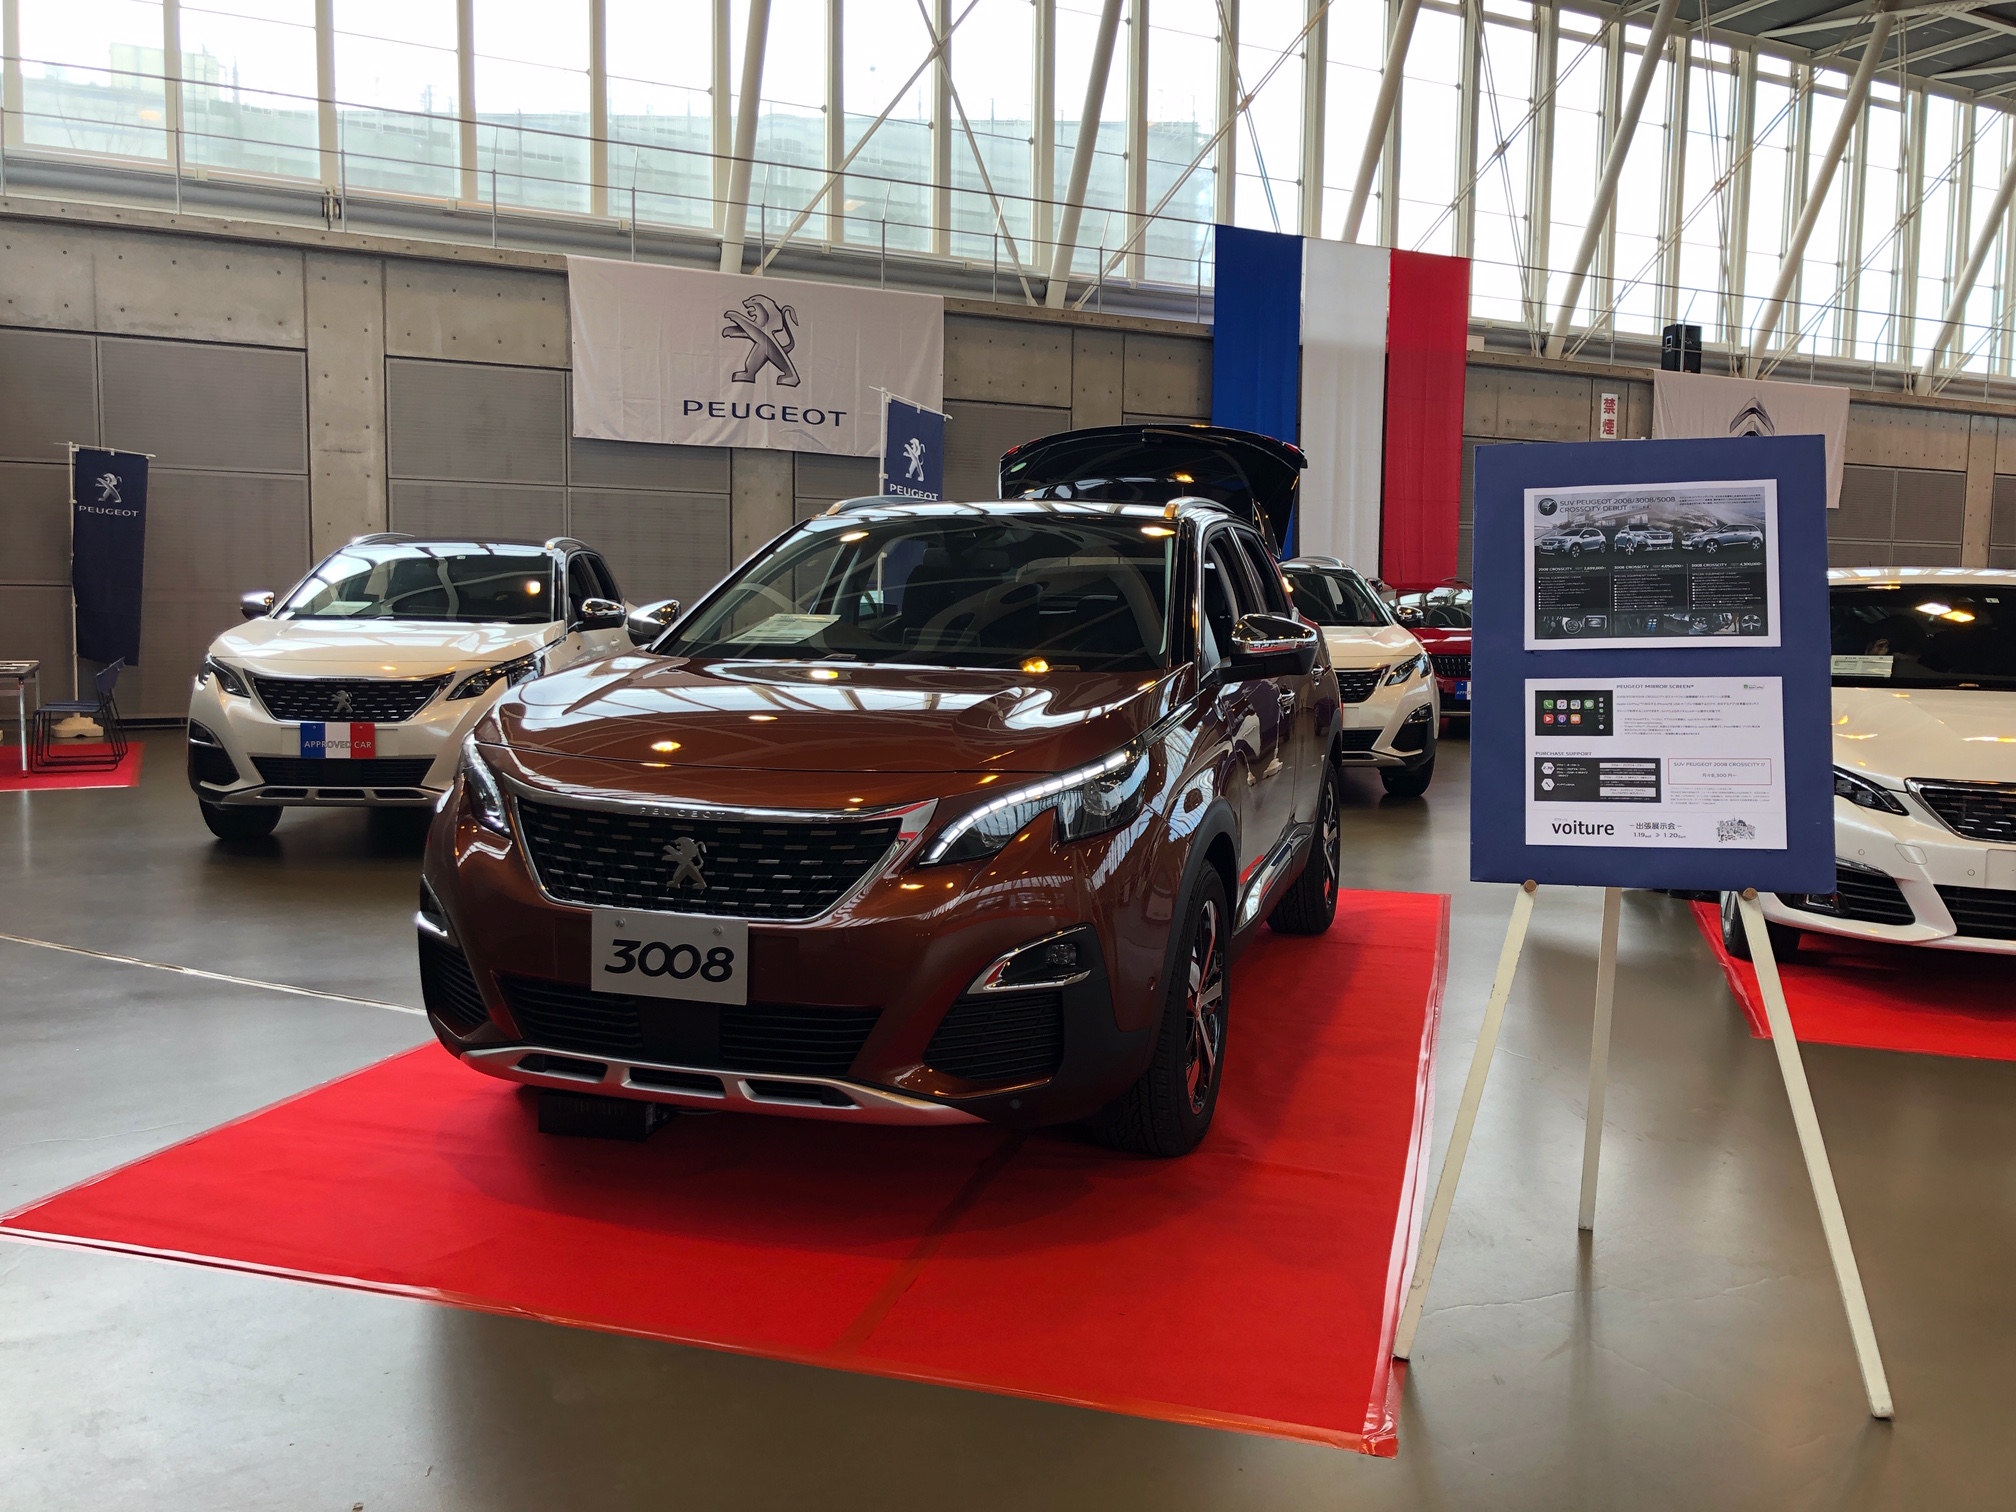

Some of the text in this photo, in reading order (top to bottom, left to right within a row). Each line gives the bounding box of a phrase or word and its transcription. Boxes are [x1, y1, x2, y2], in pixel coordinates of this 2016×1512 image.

[683, 399, 848, 427] PEUGEOT
[1602, 397, 1616, 436] 禁煙
[889, 483, 939, 501] PEUGEOT
[1559, 505, 1601, 513] CROSSCITY
[1602, 504, 1628, 512] DEBUT
[1576, 498, 1612, 506] PEUGEOT
[78, 505, 140, 517] PEUGEOT
[304, 740, 372, 749] APPROVED CAR
[640, 806, 726, 820] PEUGEOT
[1551, 819, 1615, 836] voiture
[603, 938, 735, 983] 3008
